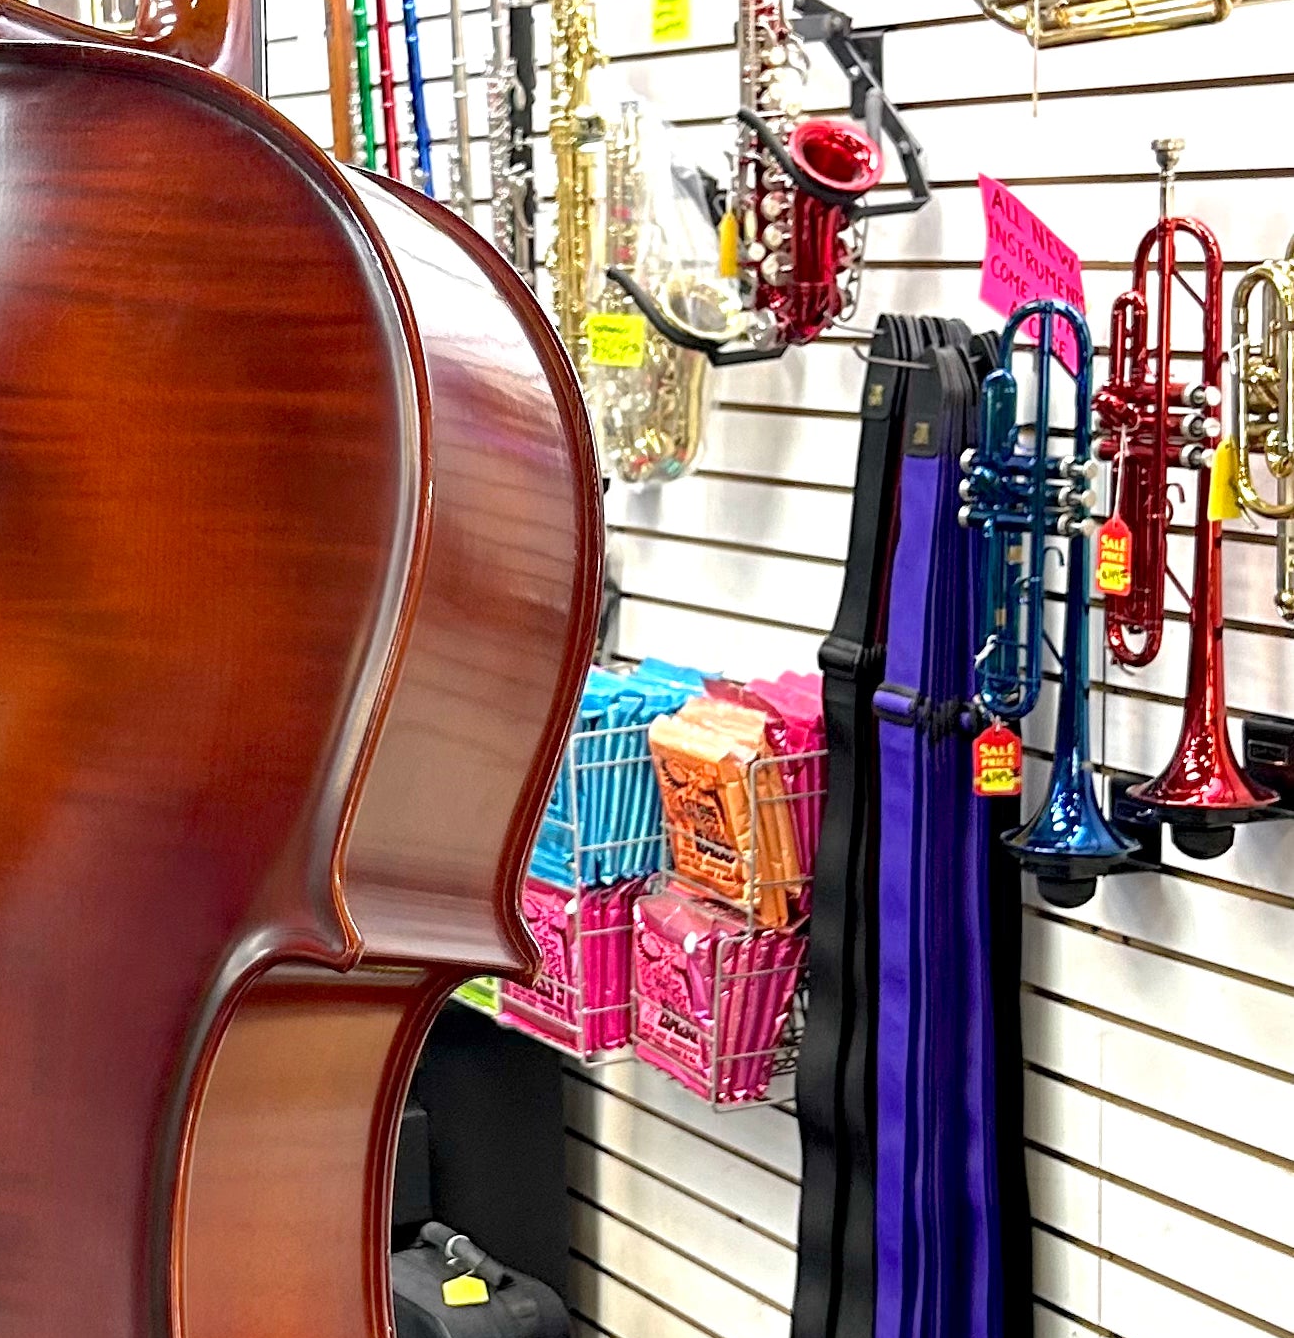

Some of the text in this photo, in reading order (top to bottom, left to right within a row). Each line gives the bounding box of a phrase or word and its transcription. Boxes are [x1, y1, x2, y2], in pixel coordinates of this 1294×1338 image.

[992, 189, 1075, 273] ALL NEW
[990, 255, 1030, 300] COME
[1100, 534, 1127, 551] SALE
[979, 741, 1015, 757] SALE
